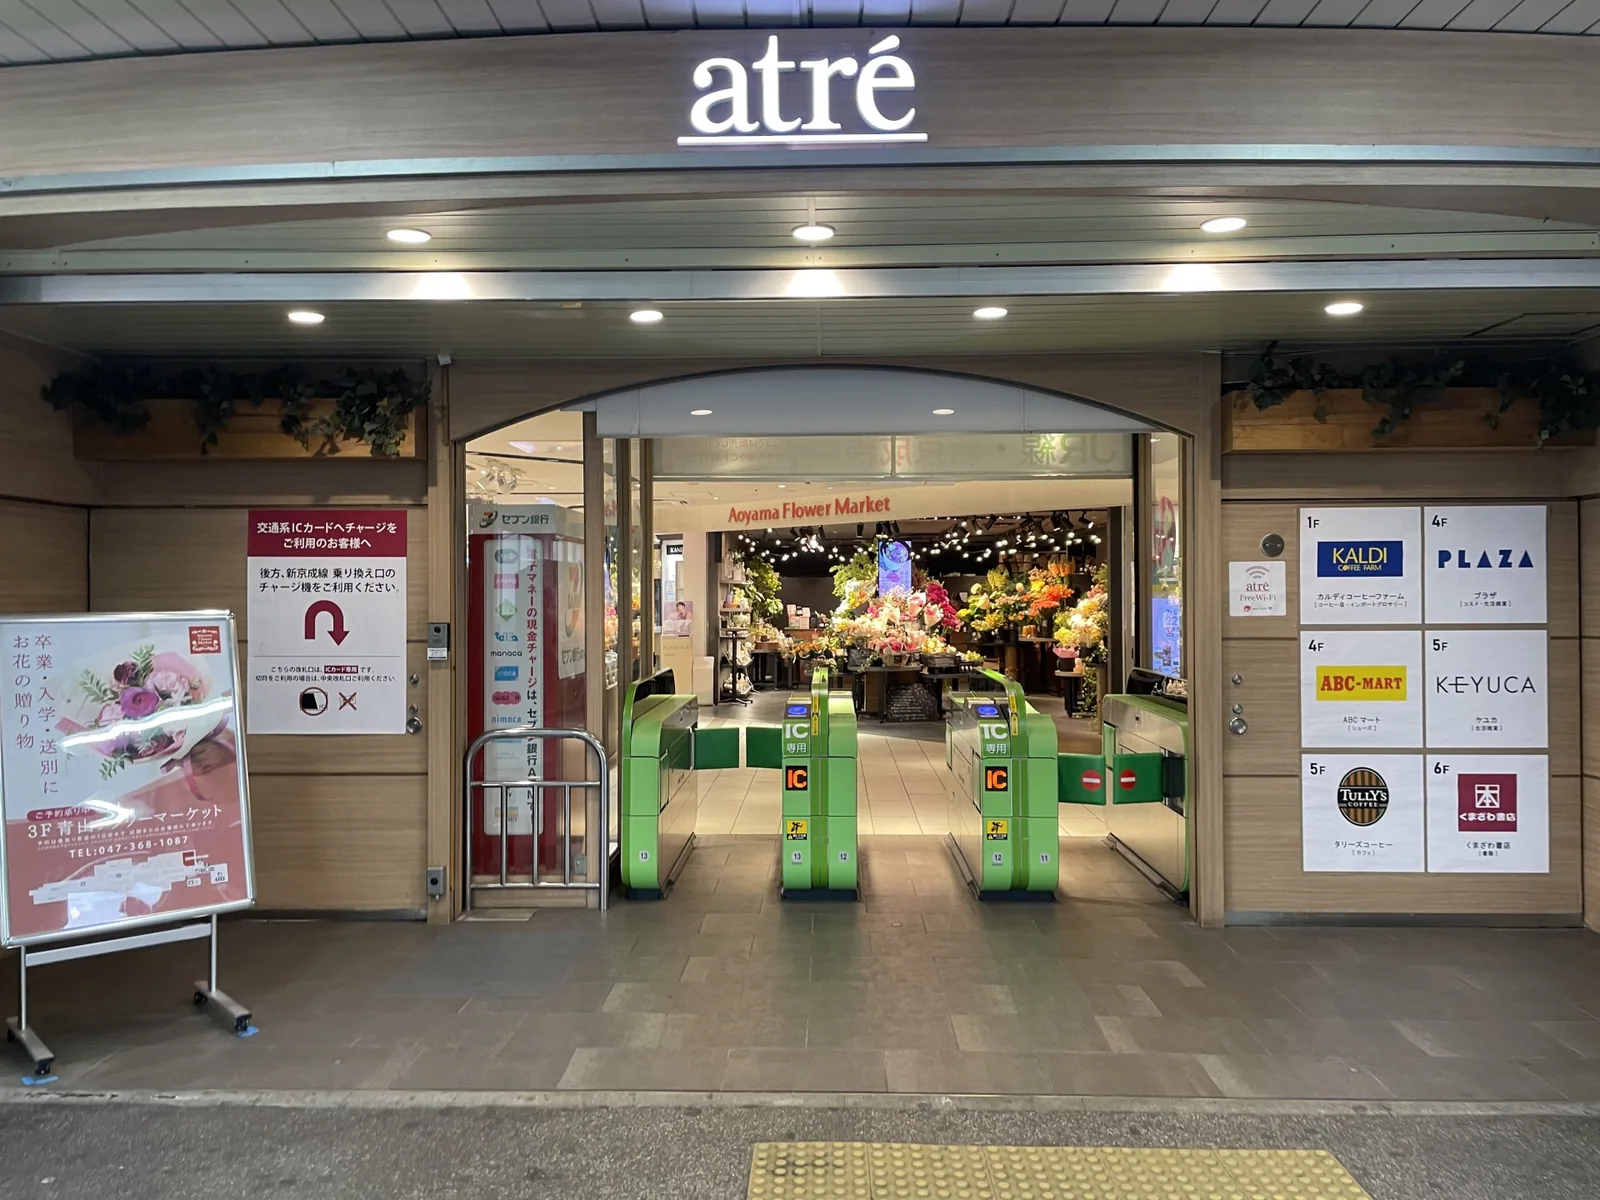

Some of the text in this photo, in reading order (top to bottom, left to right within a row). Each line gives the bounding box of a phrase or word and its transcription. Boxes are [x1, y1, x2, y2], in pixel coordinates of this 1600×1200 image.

[691, 34, 916, 134] atré
[728, 495, 891, 525] Aoyama Flower Market
[501, 514, 550, 525] セブン銀行
[1306, 515, 1320, 529] 1F
[1431, 514, 1448, 528] 4F
[256, 521, 398, 534] 交通系ICカードへチャージを
[283, 537, 372, 550] ご利用のお客様へ
[1332, 546, 1388, 564] KALDI
[1437, 549, 1535, 569] PLAZA
[332, 567, 396, 579] 乗り換え口の
[1337, 564, 1382, 572] COFFEE FARM
[1246, 581, 1270, 592] atré
[1317, 592, 1405, 601] カルディコーヒーファーム
[1308, 639, 1325, 652] 4F
[1432, 638, 1449, 652] 5F
[1320, 674, 1403, 692] ABC-MART
[1436, 675, 1537, 694] KEYUCA
[12, 635, 35, 750] お花の贈り物
[34, 634, 59, 795] 卒業・入学・送別に
[491, 715, 522, 724] nimoca
[785, 723, 809, 739] IC
[980, 723, 1008, 740] IC
[787, 742, 807, 754] 専用
[986, 743, 1007, 755] 専用
[1309, 762, 1326, 775] 5F
[1433, 761, 1450, 775] 6F
[787, 769, 808, 789] IC
[986, 770, 1008, 789] IC
[1459, 812, 1517, 822] くまざわ書店
[27, 822, 52, 839] 3F
[1334, 840, 1394, 849] タリーズコーヒー
[1466, 841, 1511, 850] くまざわ書店
[640, 852, 648, 860] 13
[794, 852, 802, 860] 13
[840, 852, 848, 861] 12
[994, 853, 1002, 861] 12
[1041, 854, 1049, 862] 11
